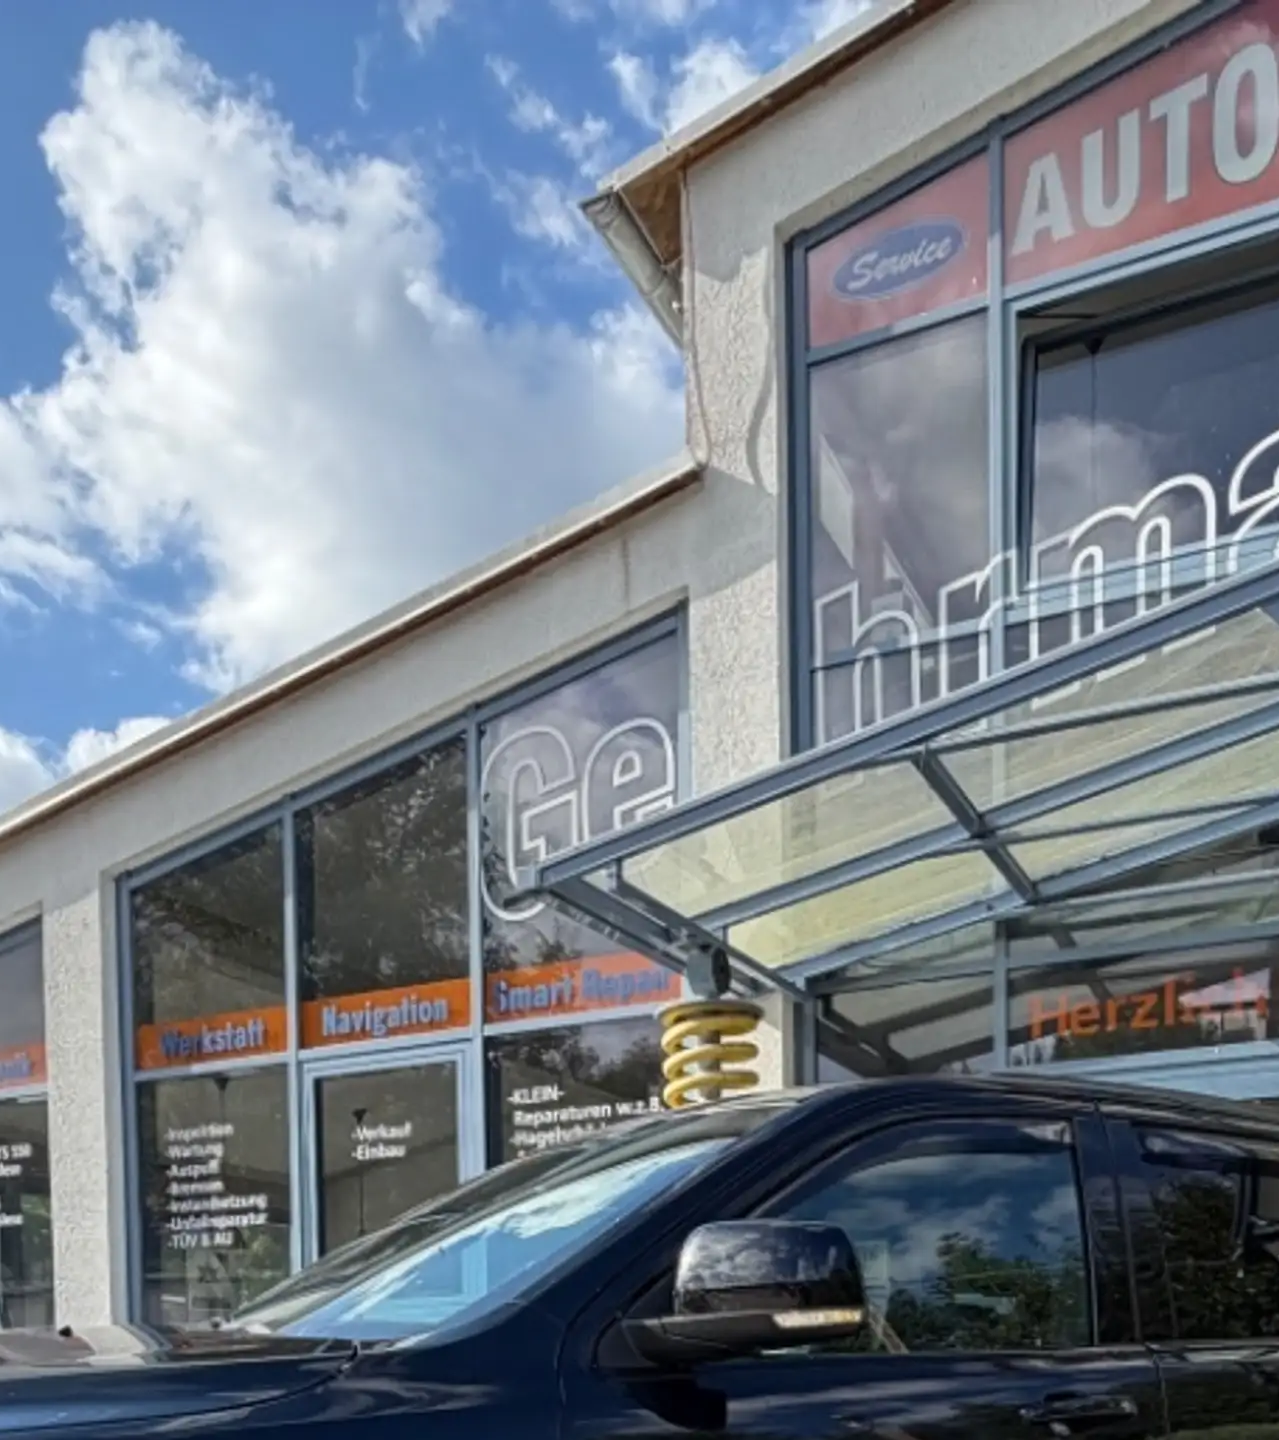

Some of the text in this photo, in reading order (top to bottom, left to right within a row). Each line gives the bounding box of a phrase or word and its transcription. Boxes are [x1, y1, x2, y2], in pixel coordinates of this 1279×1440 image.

[846, 236, 952, 291] Service
[493, 965, 669, 1014] Smart Repair
[322, 996, 449, 1037] Navigation
[160, 1018, 266, 1058] Werkstatt
[512, 1103, 612, 1128] Reparaturen
